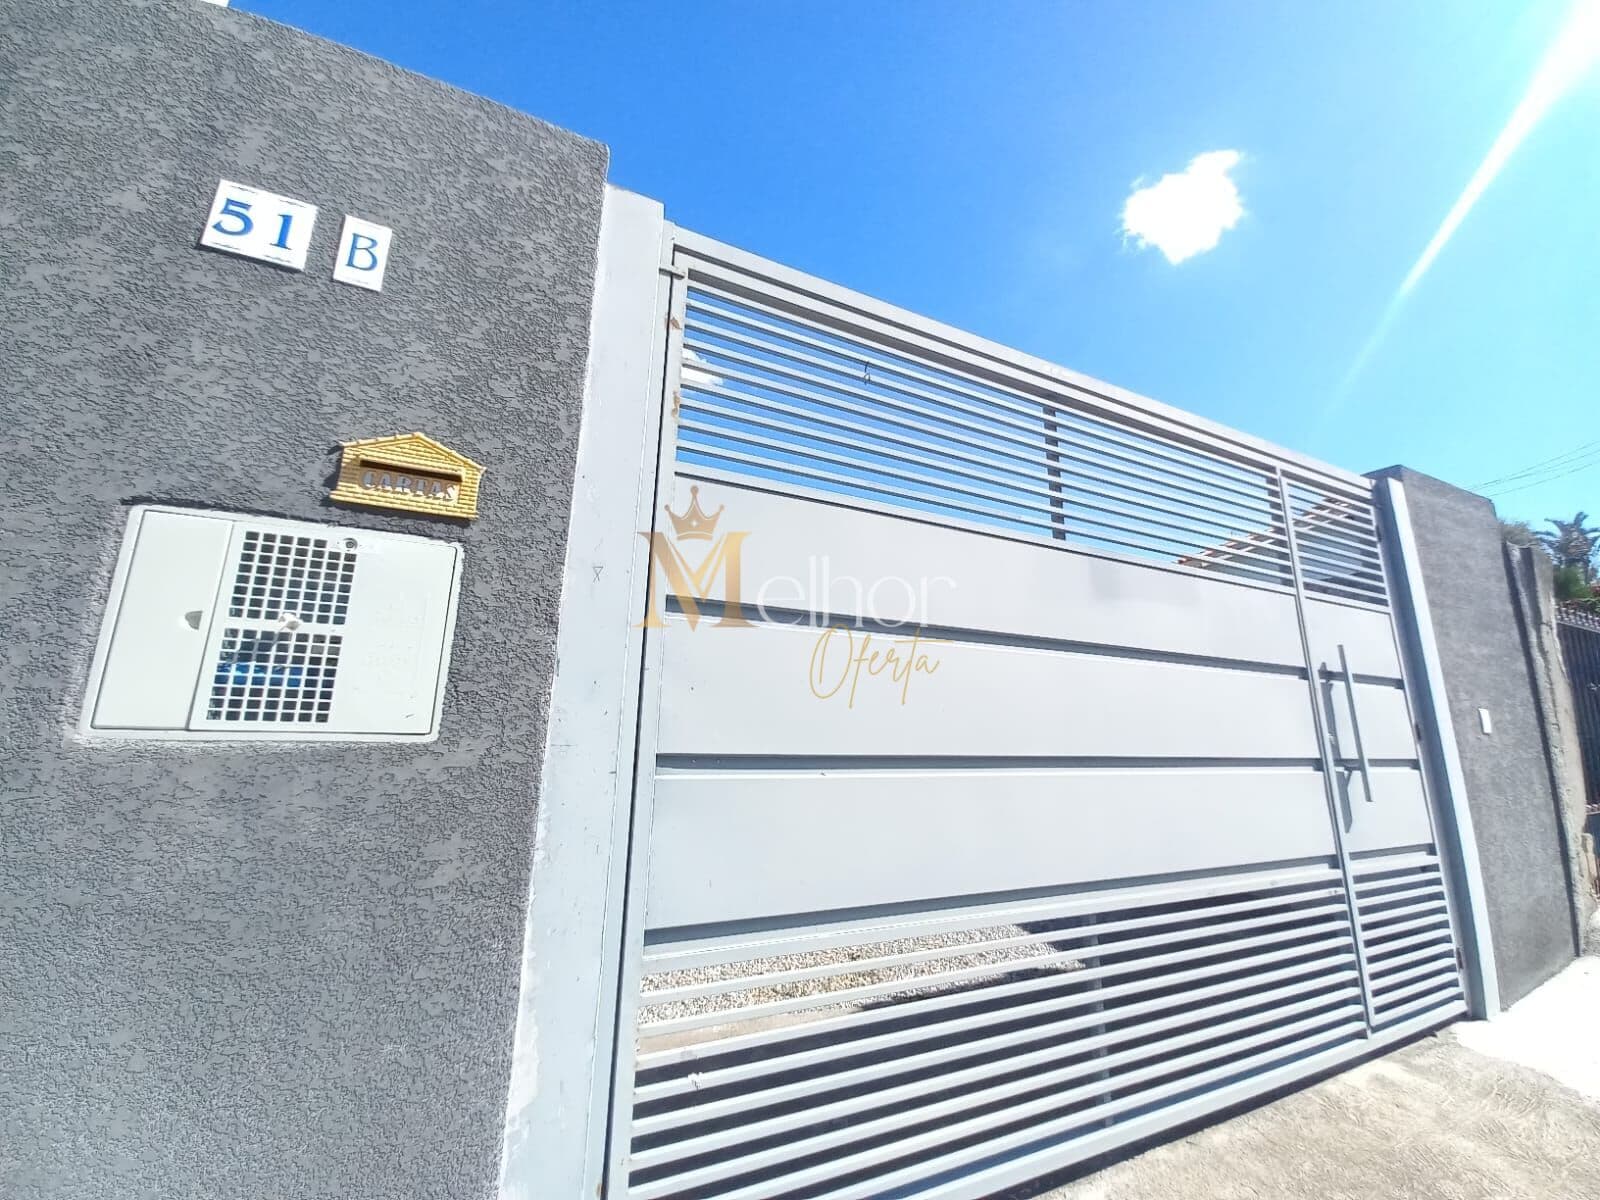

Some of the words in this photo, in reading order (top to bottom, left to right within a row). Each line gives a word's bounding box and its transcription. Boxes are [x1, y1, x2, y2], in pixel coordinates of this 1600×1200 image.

[212, 198, 293, 250] 51
[346, 232, 378, 271] B
[361, 470, 459, 501] CARTAS
